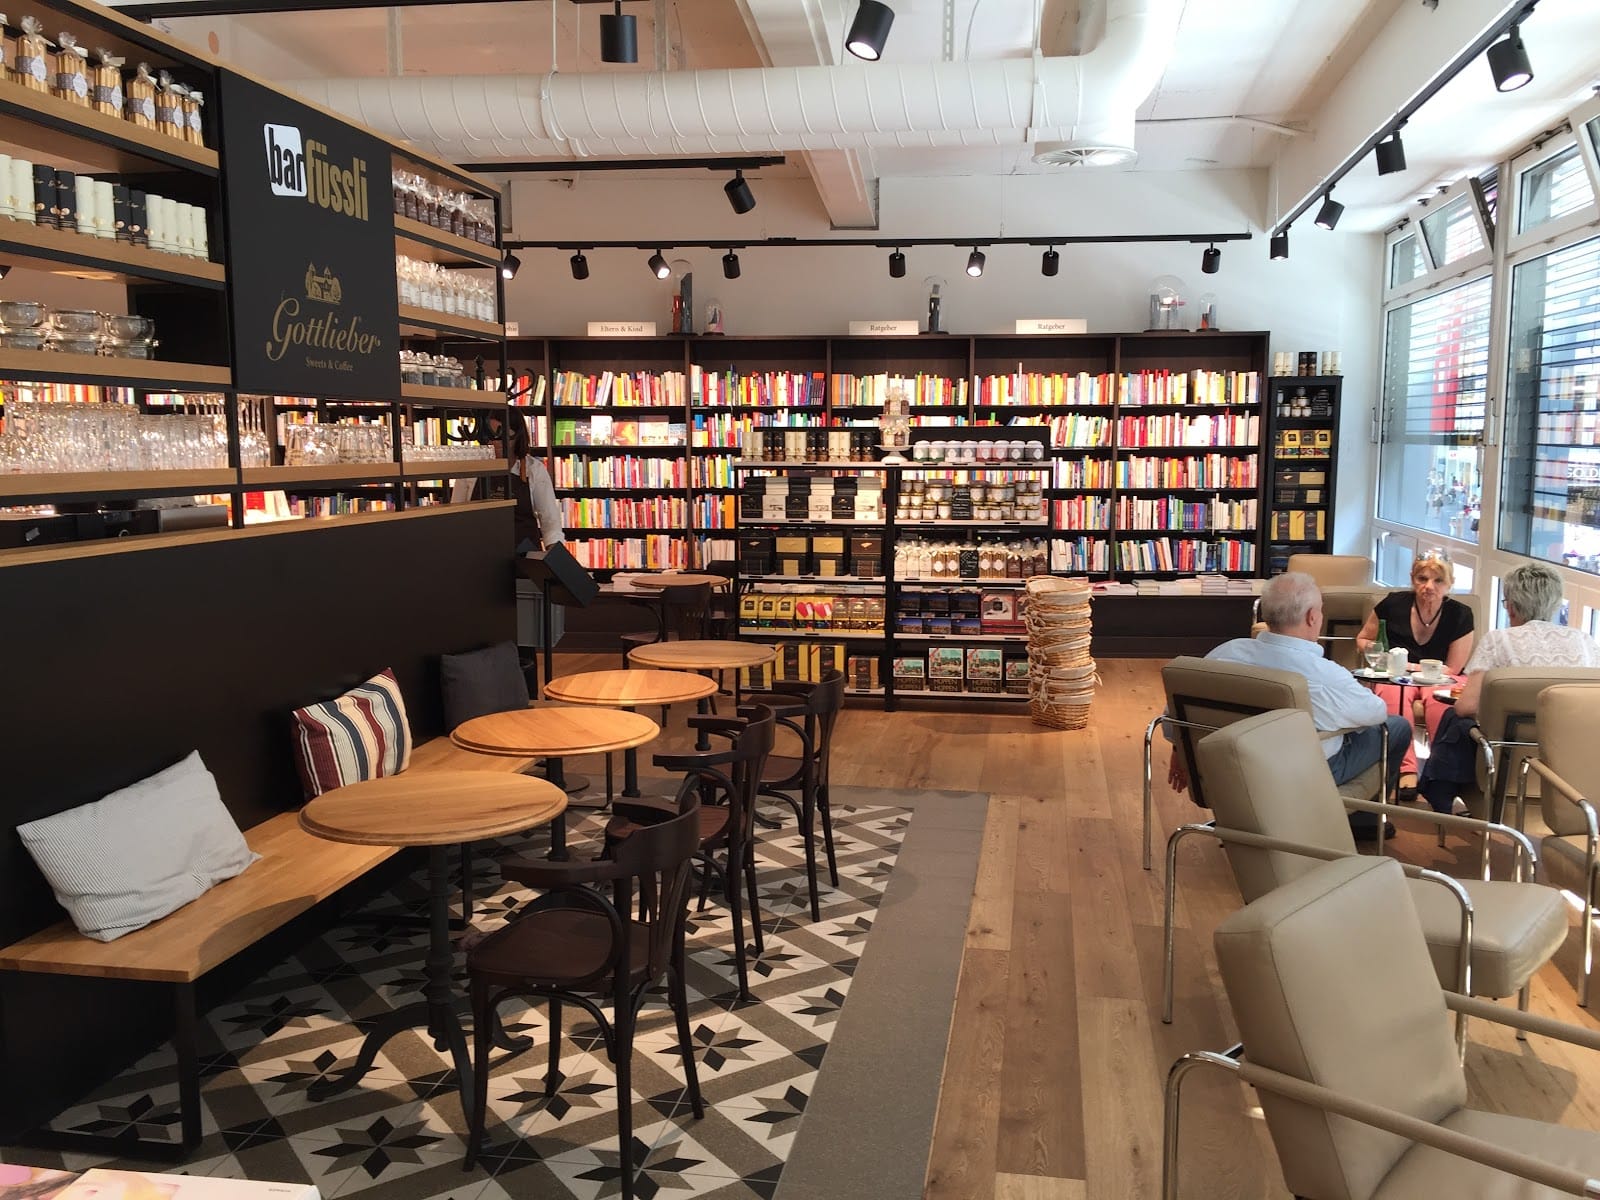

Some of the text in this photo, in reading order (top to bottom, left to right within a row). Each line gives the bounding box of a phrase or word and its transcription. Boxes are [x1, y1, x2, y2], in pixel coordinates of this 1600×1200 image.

[266, 297, 381, 361] Gottlieber
[600, 325, 619, 333] Eltern
[628, 325, 643, 333] Kind
[870, 324, 897, 332] Ratgeber
[1037, 323, 1065, 331] Ratgeber
[305, 357, 327, 369] Sweets
[335, 360, 353, 371] Coffee
